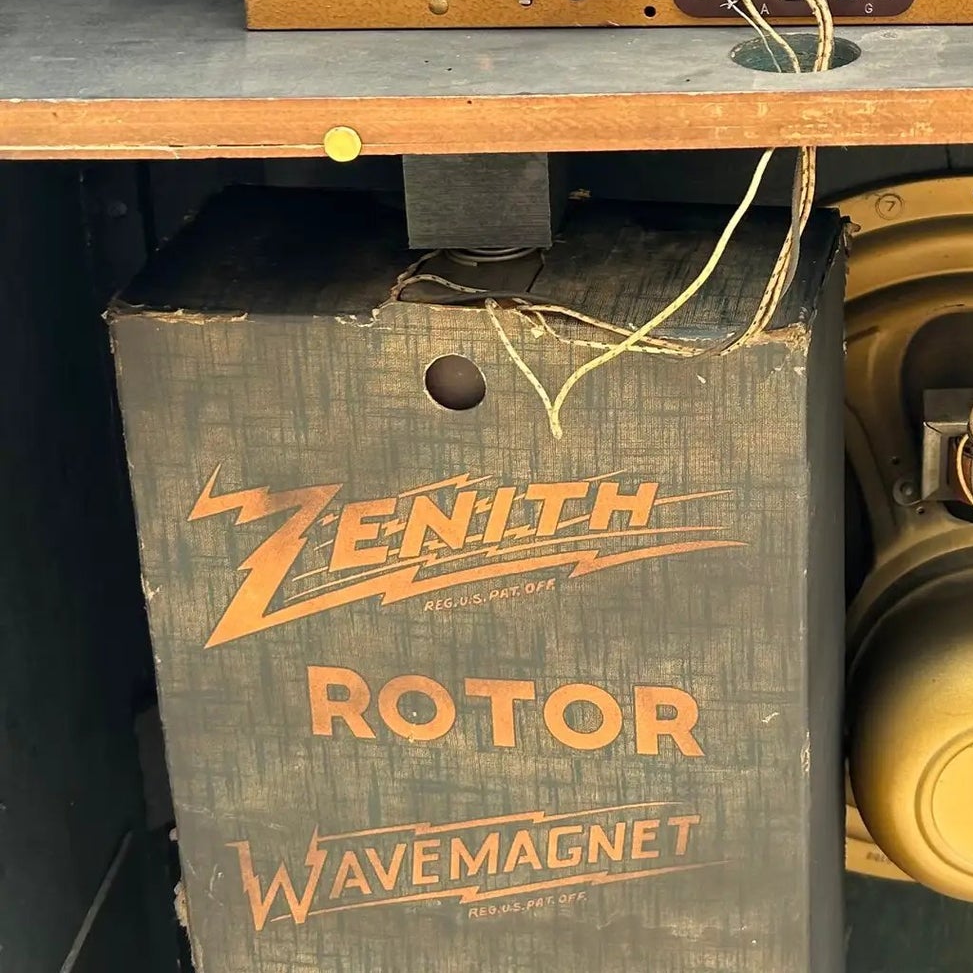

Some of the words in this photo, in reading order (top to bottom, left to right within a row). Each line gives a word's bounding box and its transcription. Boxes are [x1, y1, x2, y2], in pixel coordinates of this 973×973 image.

[760, 5, 770, 15] A
[864, 3, 873, 14] G
[188, 464, 660, 648] ZENITH
[307, 665, 704, 757] ROTOR
[226, 814, 701, 931] WAVEMAGNET
